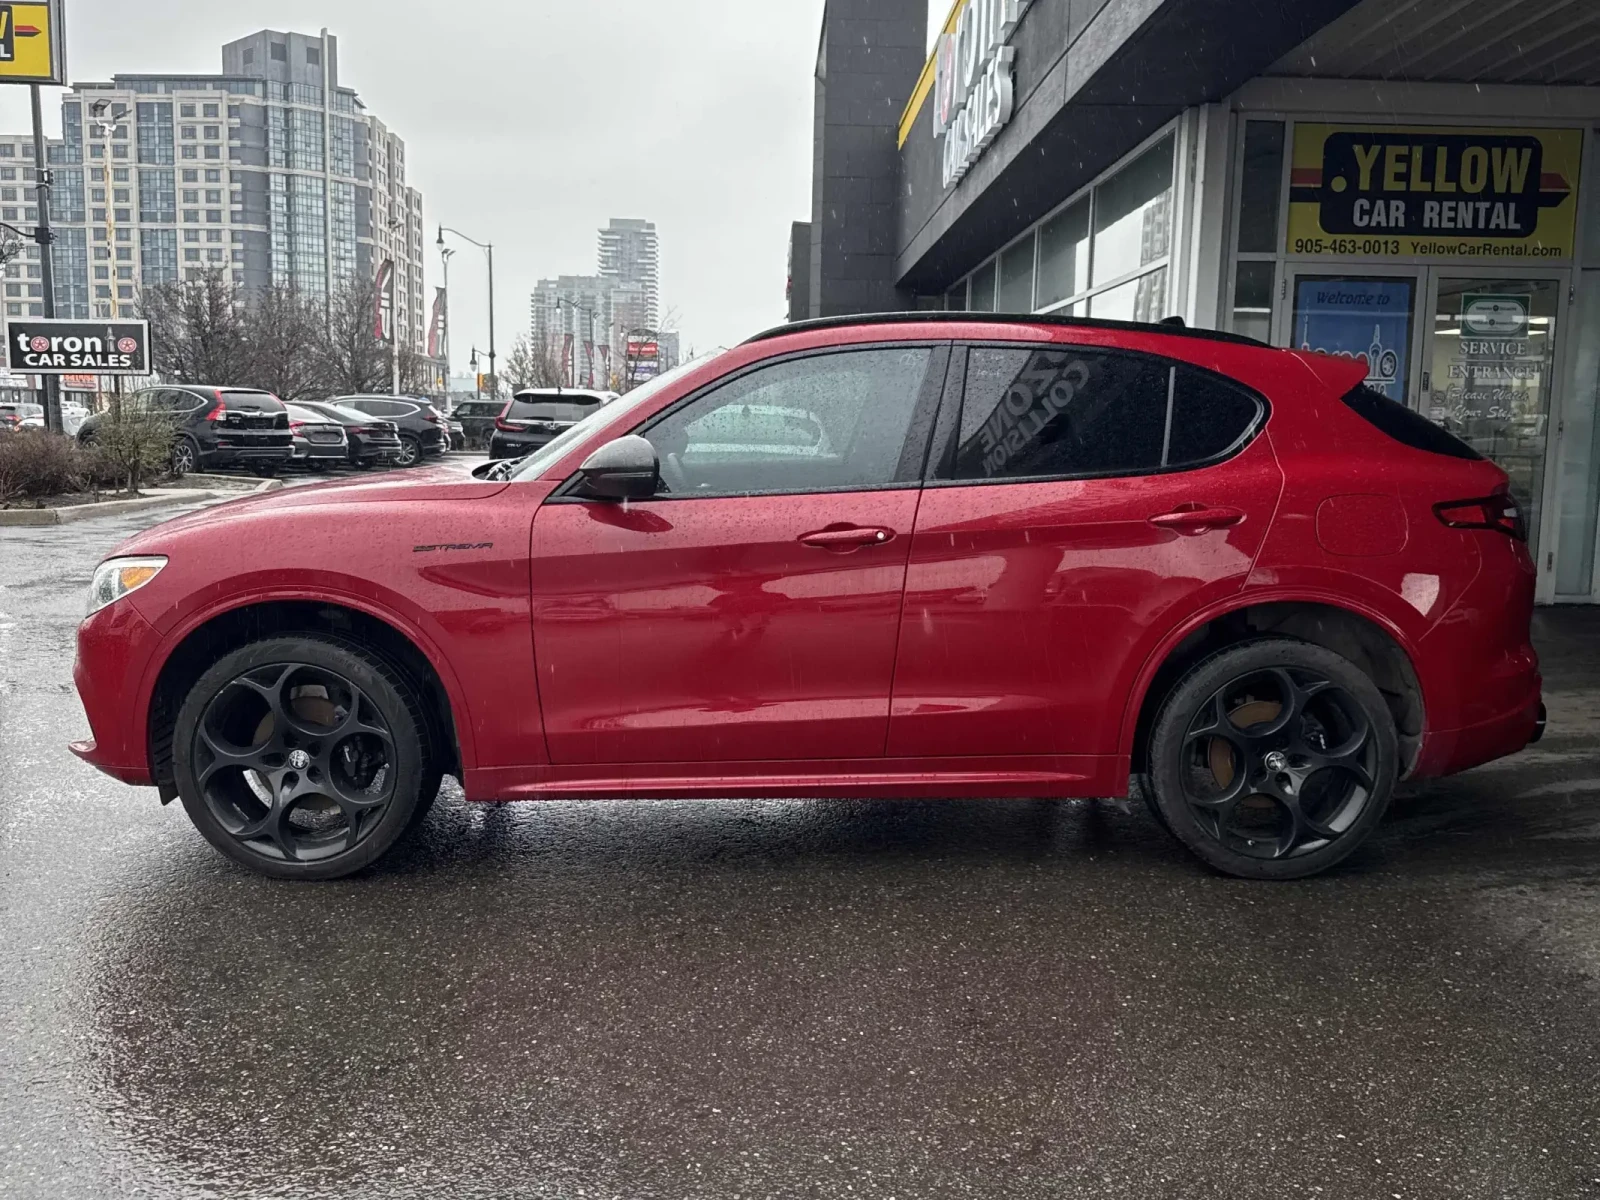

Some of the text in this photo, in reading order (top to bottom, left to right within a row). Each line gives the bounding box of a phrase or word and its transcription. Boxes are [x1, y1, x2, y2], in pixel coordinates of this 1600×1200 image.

[1352, 144, 1532, 194] YELLOW
[1352, 198, 1522, 230] CAR RENTAL
[1294, 238, 1562, 258] 905-463-0013 YellowCarRental.com
[1316, 291, 1391, 306] Welcome to
[1459, 341, 1526, 355] SERVICE
[24, 353, 131, 367] CAR SALES
[1448, 364, 1535, 380] ENTRANCE
[1491, 387, 1529, 401] Watch
[412, 542, 494, 553] ESTREMA
